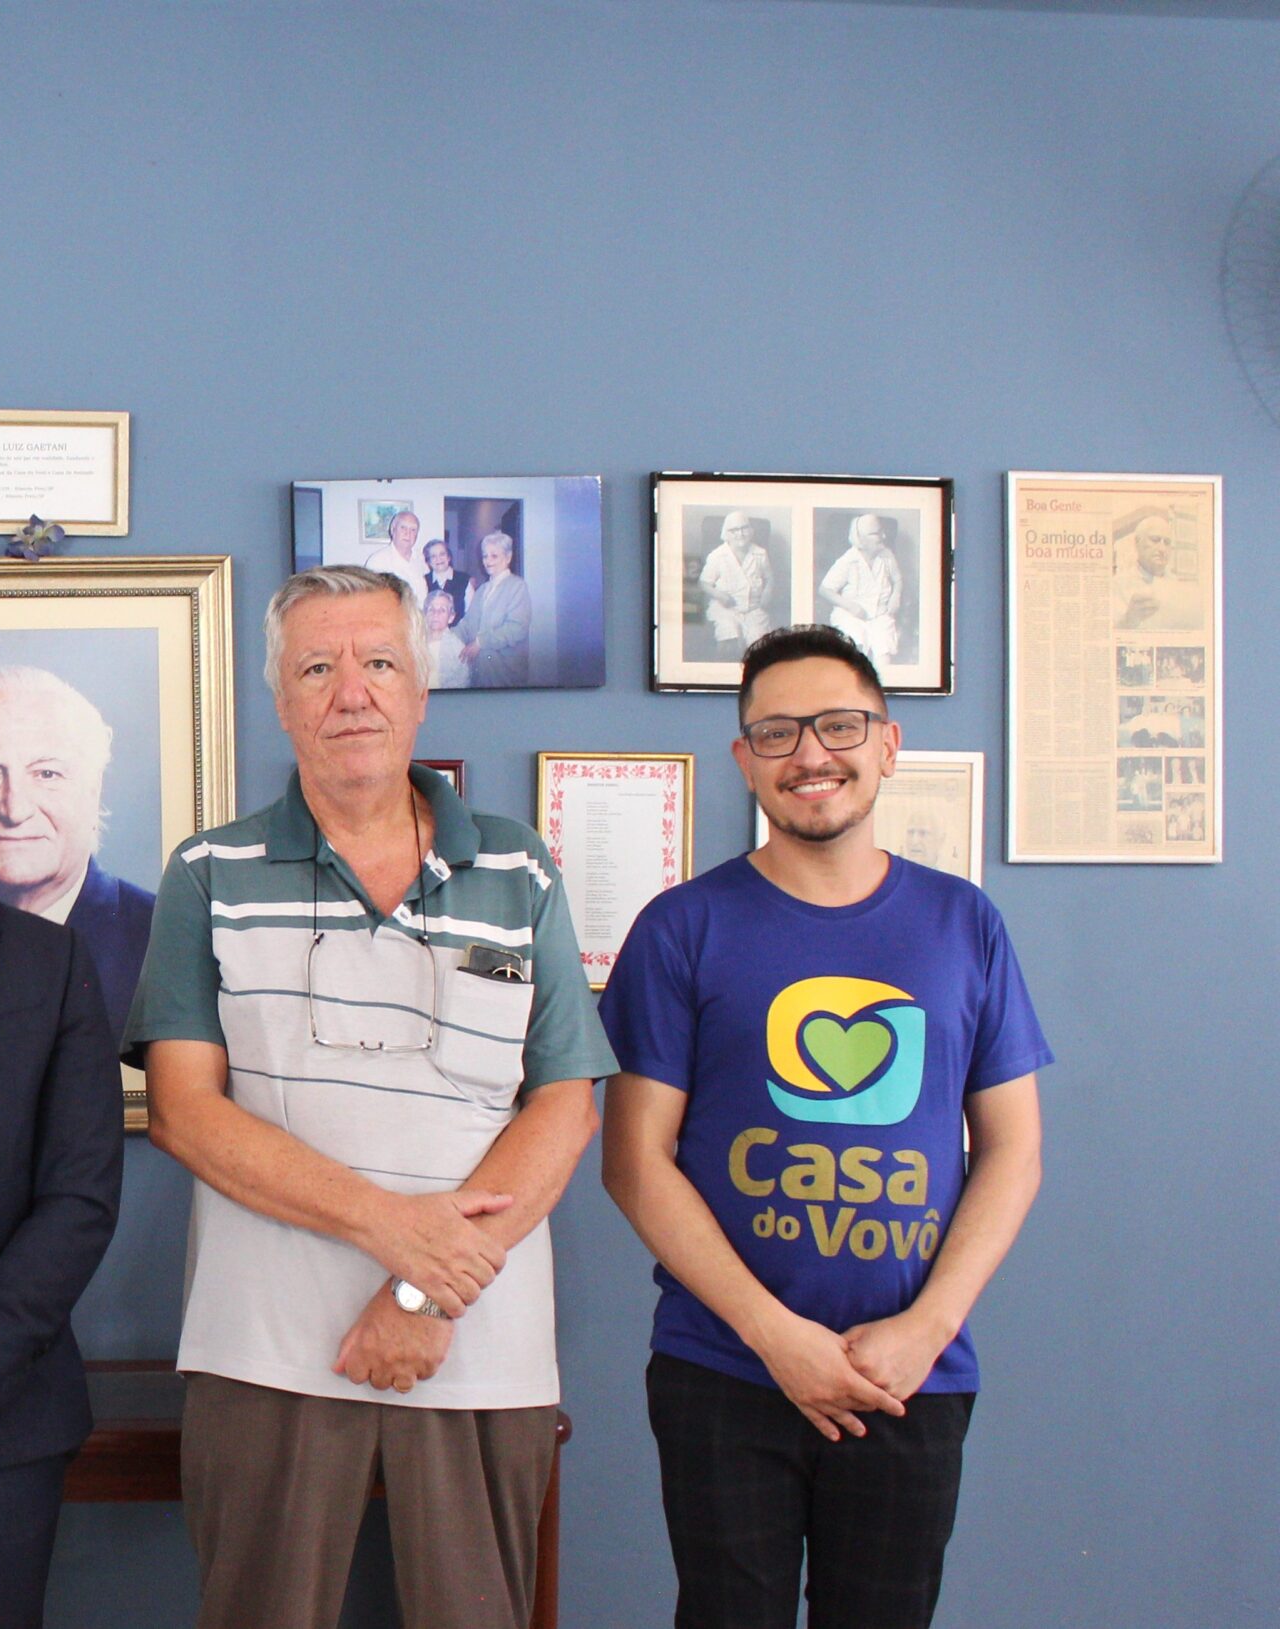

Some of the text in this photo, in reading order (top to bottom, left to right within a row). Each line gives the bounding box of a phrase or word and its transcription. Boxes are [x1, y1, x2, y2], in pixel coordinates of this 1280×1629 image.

[3, 443, 24, 452] LUIZ
[26, 443, 68, 452] GAETANI
[1026, 499, 1083, 512] Boa Gente
[1025, 529, 1107, 549] O amigo da
[1025, 544, 1052, 558] boa
[728, 1127, 929, 1206] Casa
[752, 1205, 941, 1261] do Vovô
